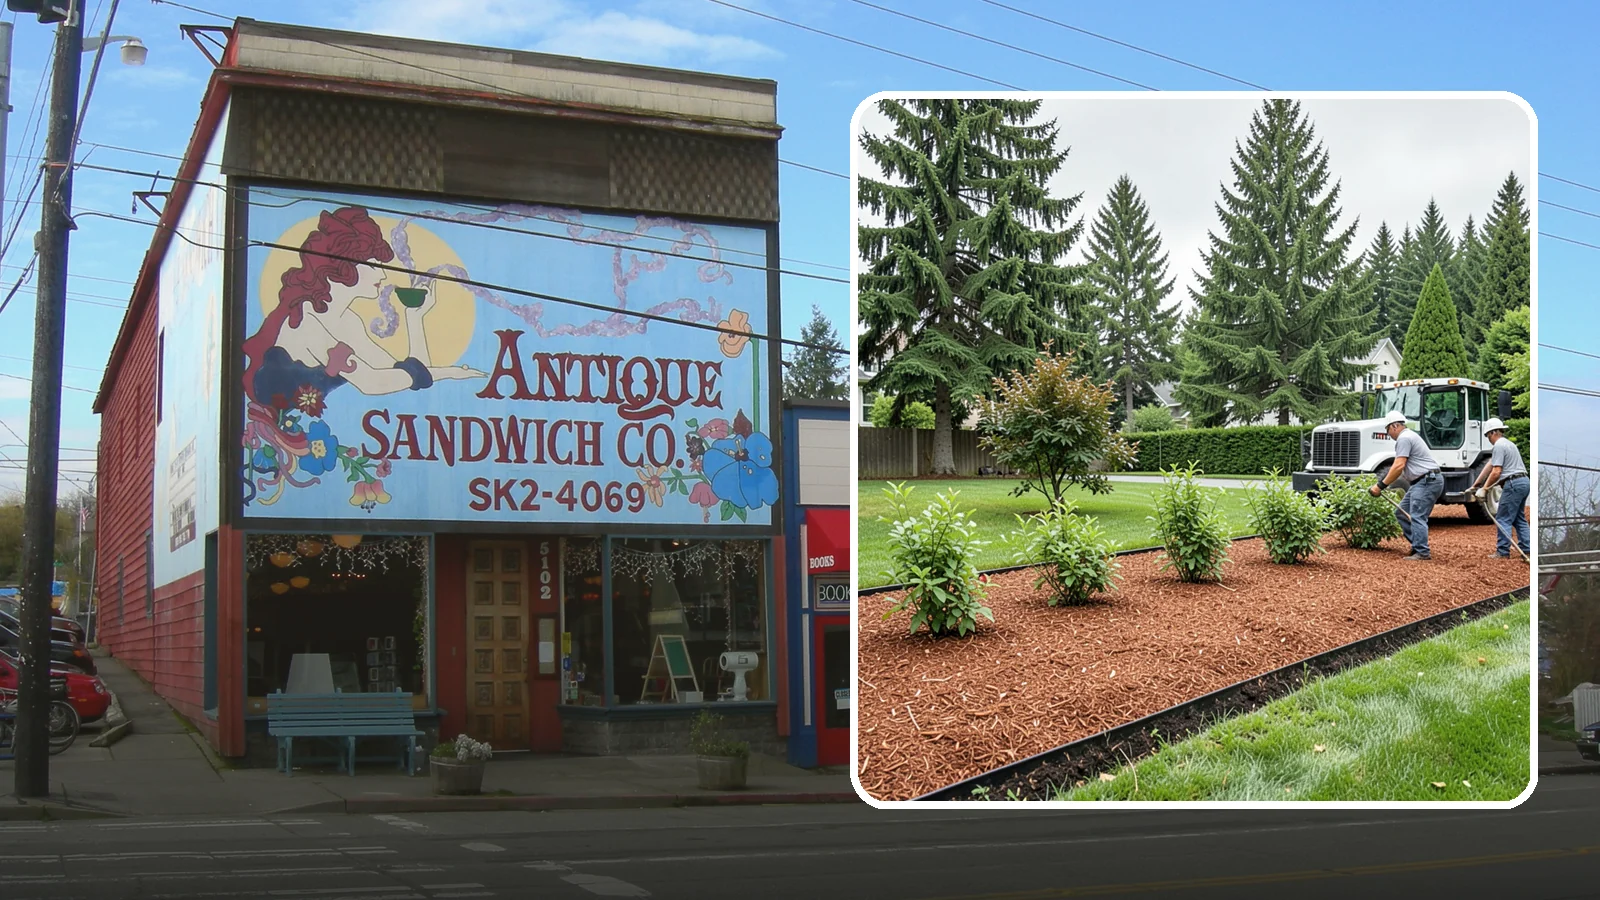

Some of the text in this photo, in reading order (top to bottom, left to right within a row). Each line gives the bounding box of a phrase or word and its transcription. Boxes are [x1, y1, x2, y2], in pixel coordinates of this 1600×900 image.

[475, 329, 723, 420] ANTIQUE
[361, 408, 685, 468] SANDWICH CO.
[468, 477, 645, 512] SK2-4069
[540, 541, 552, 600] 5102
[809, 555, 835, 569] BOOKS
